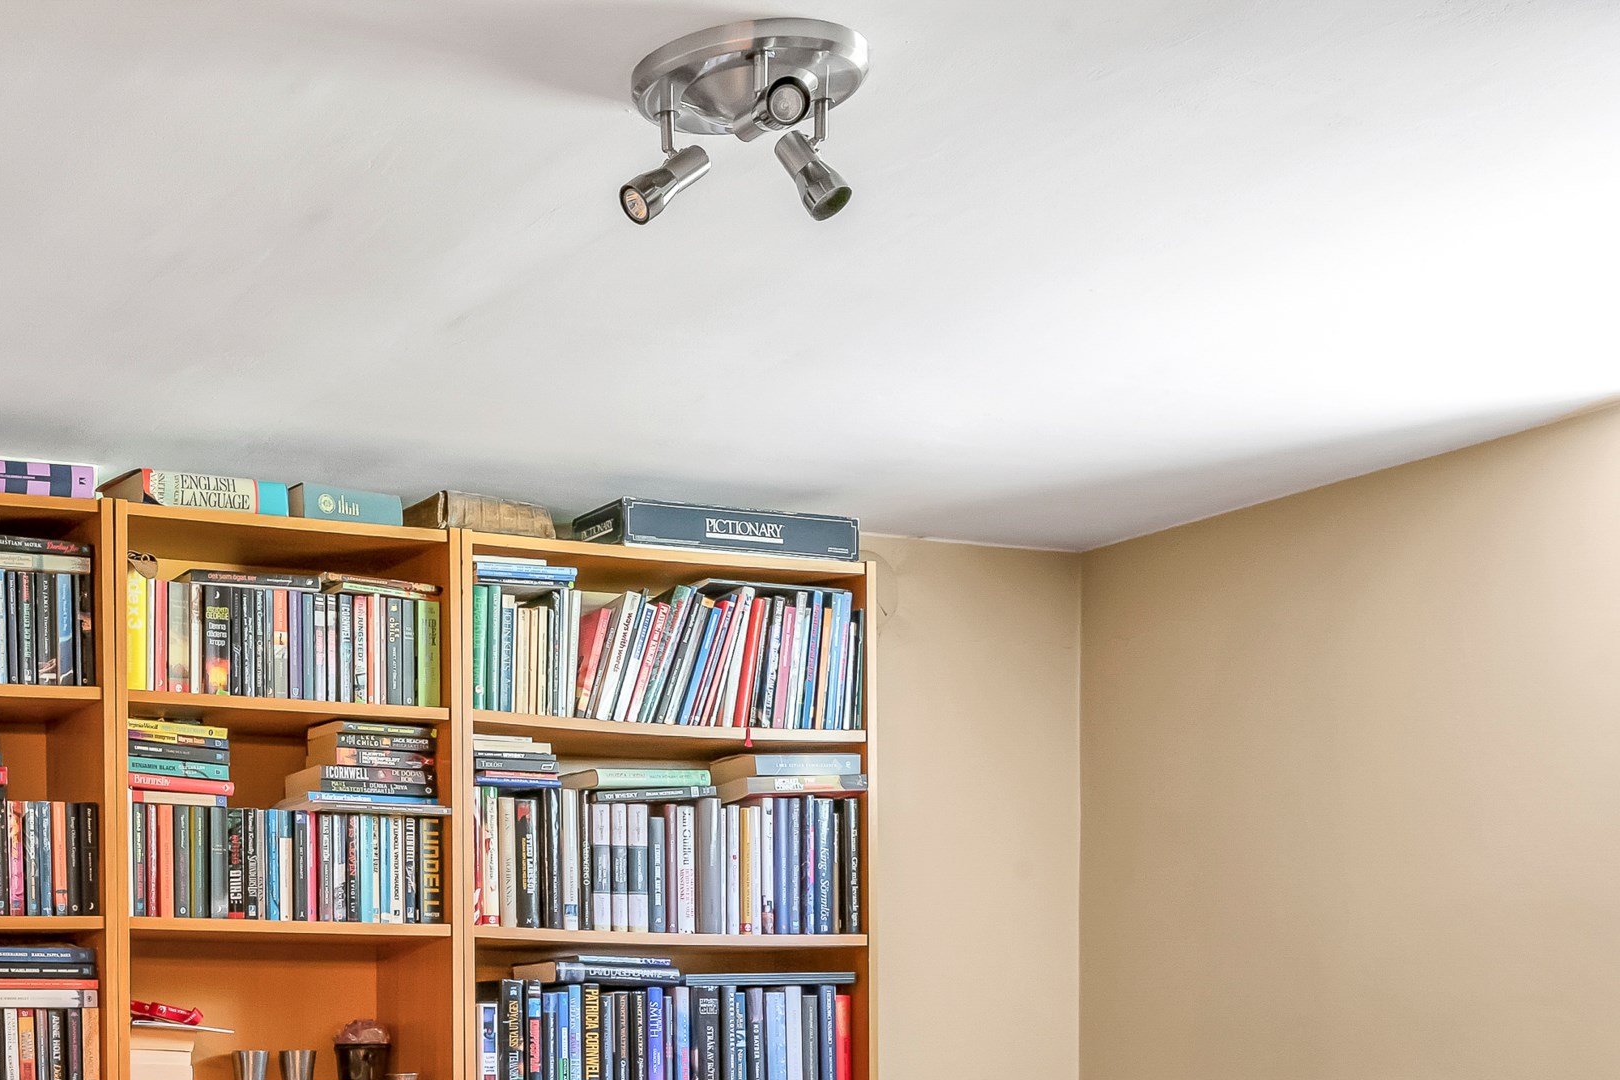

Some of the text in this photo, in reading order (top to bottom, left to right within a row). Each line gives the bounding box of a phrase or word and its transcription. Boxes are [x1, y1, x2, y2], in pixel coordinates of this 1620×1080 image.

[180, 475, 236, 494] ENGLISH
[180, 488, 250, 511] LANGUAGE
[580, 518, 614, 540] PICTIONARY
[705, 517, 785, 540] PICTIONARY
[357, 616, 365, 663] JUNGSTEDT
[503, 612, 512, 671] JOHN KEATS
[612, 612, 634, 673] ways with words
[422, 819, 440, 913] LUNDELL
[52, 1015, 60, 1037] ANNE
[649, 1001, 658, 1038] SMITH
[585, 989, 599, 1080] PATRICIA CORNWELL
[53, 1039, 61, 1061] HOLT
[53, 1064, 61, 1080] Död
